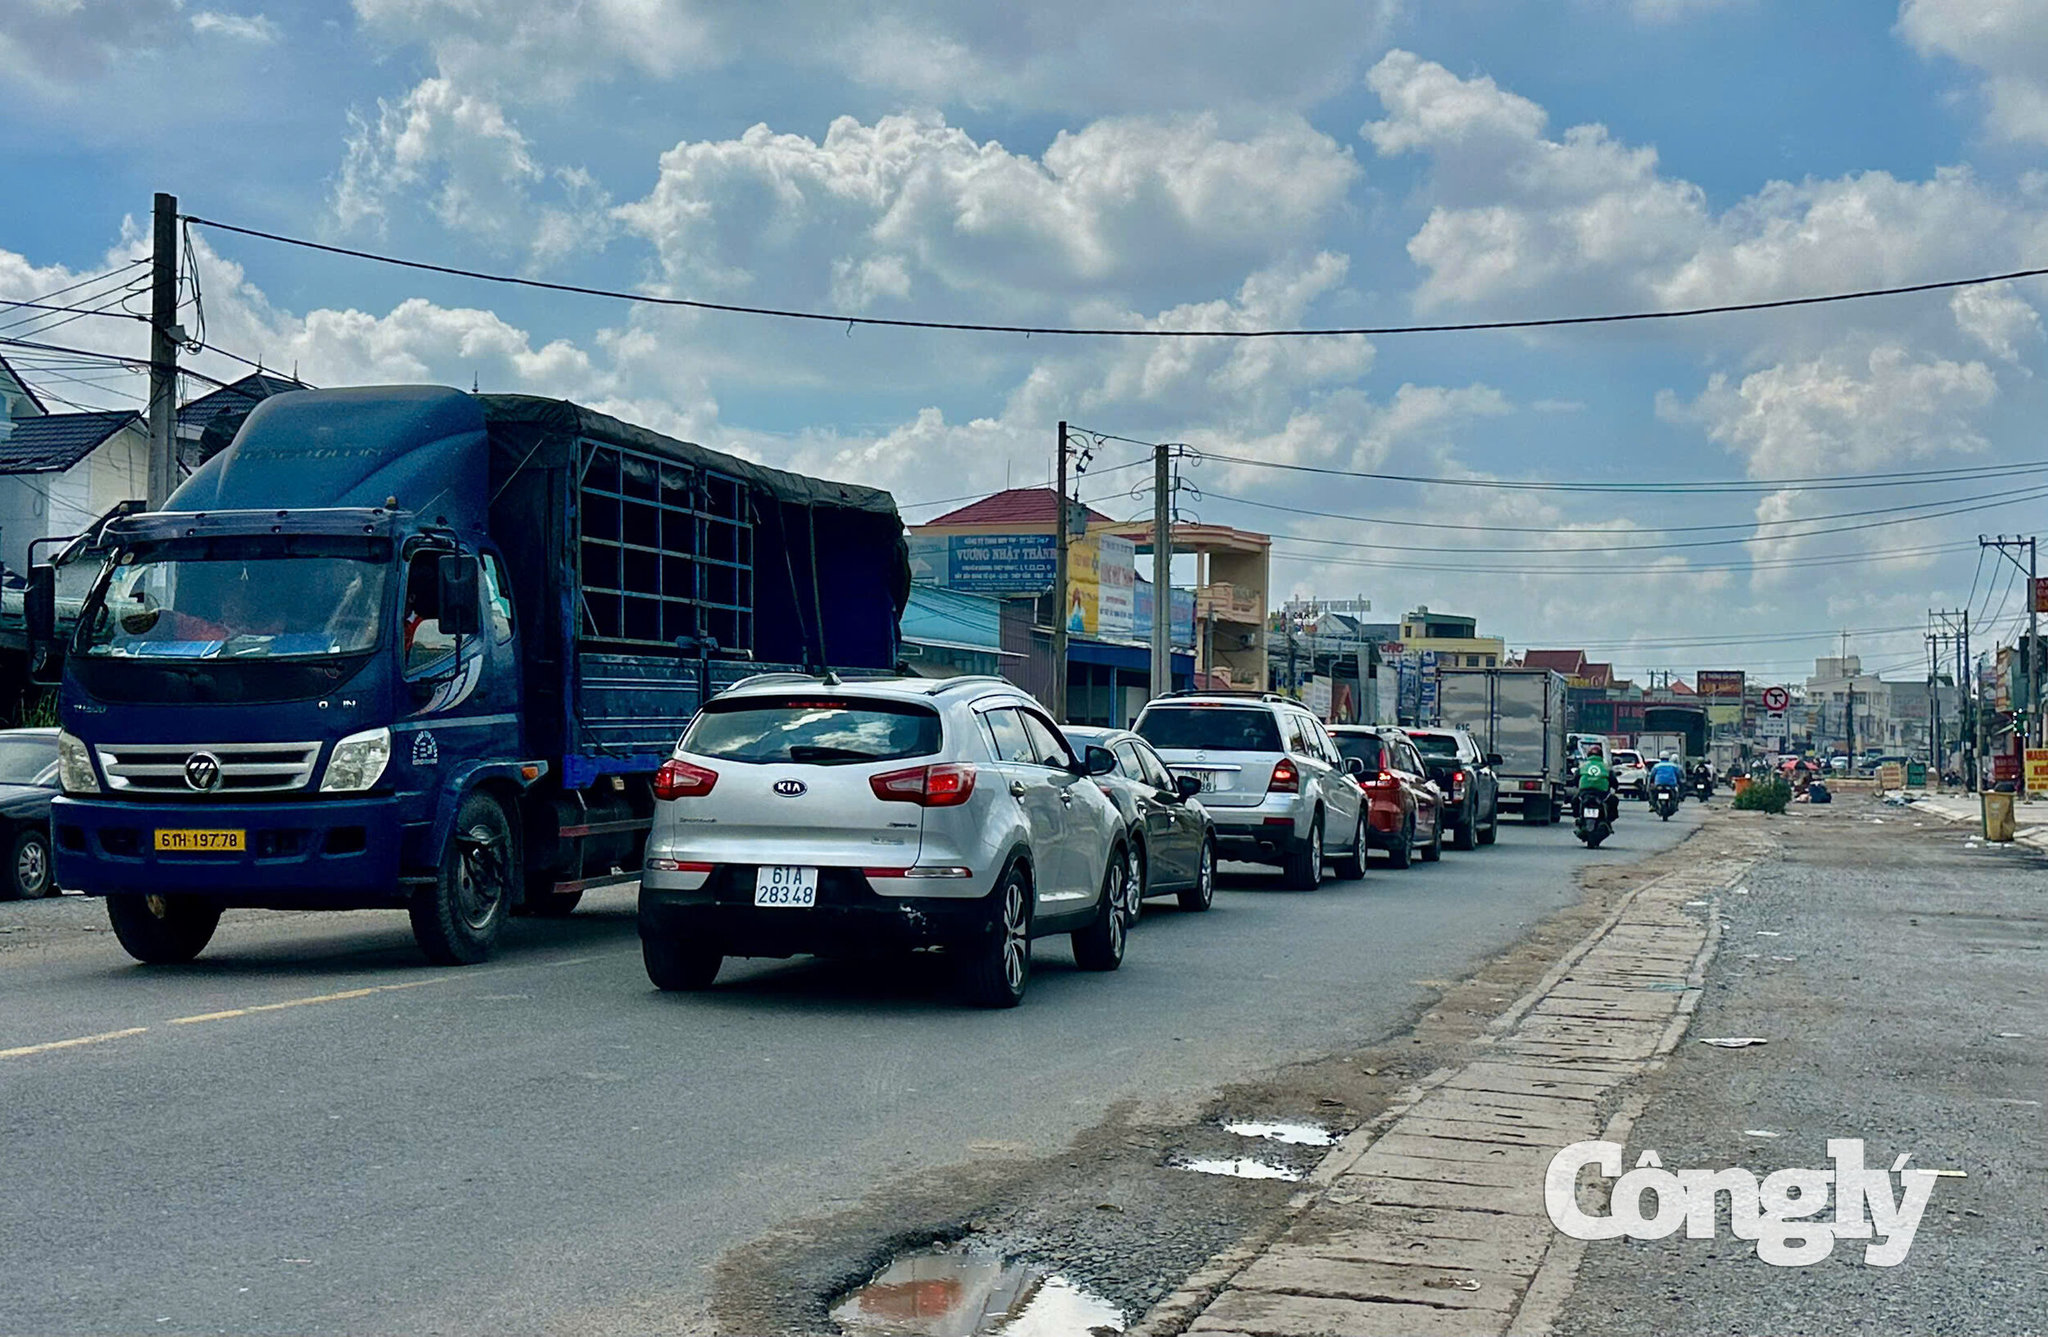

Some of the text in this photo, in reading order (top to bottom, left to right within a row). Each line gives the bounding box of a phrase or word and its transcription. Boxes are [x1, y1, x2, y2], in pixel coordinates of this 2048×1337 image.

[992, 545, 1020, 563] NHẬT
[777, 782, 800, 792] KIA
[772, 867, 802, 885] 61A
